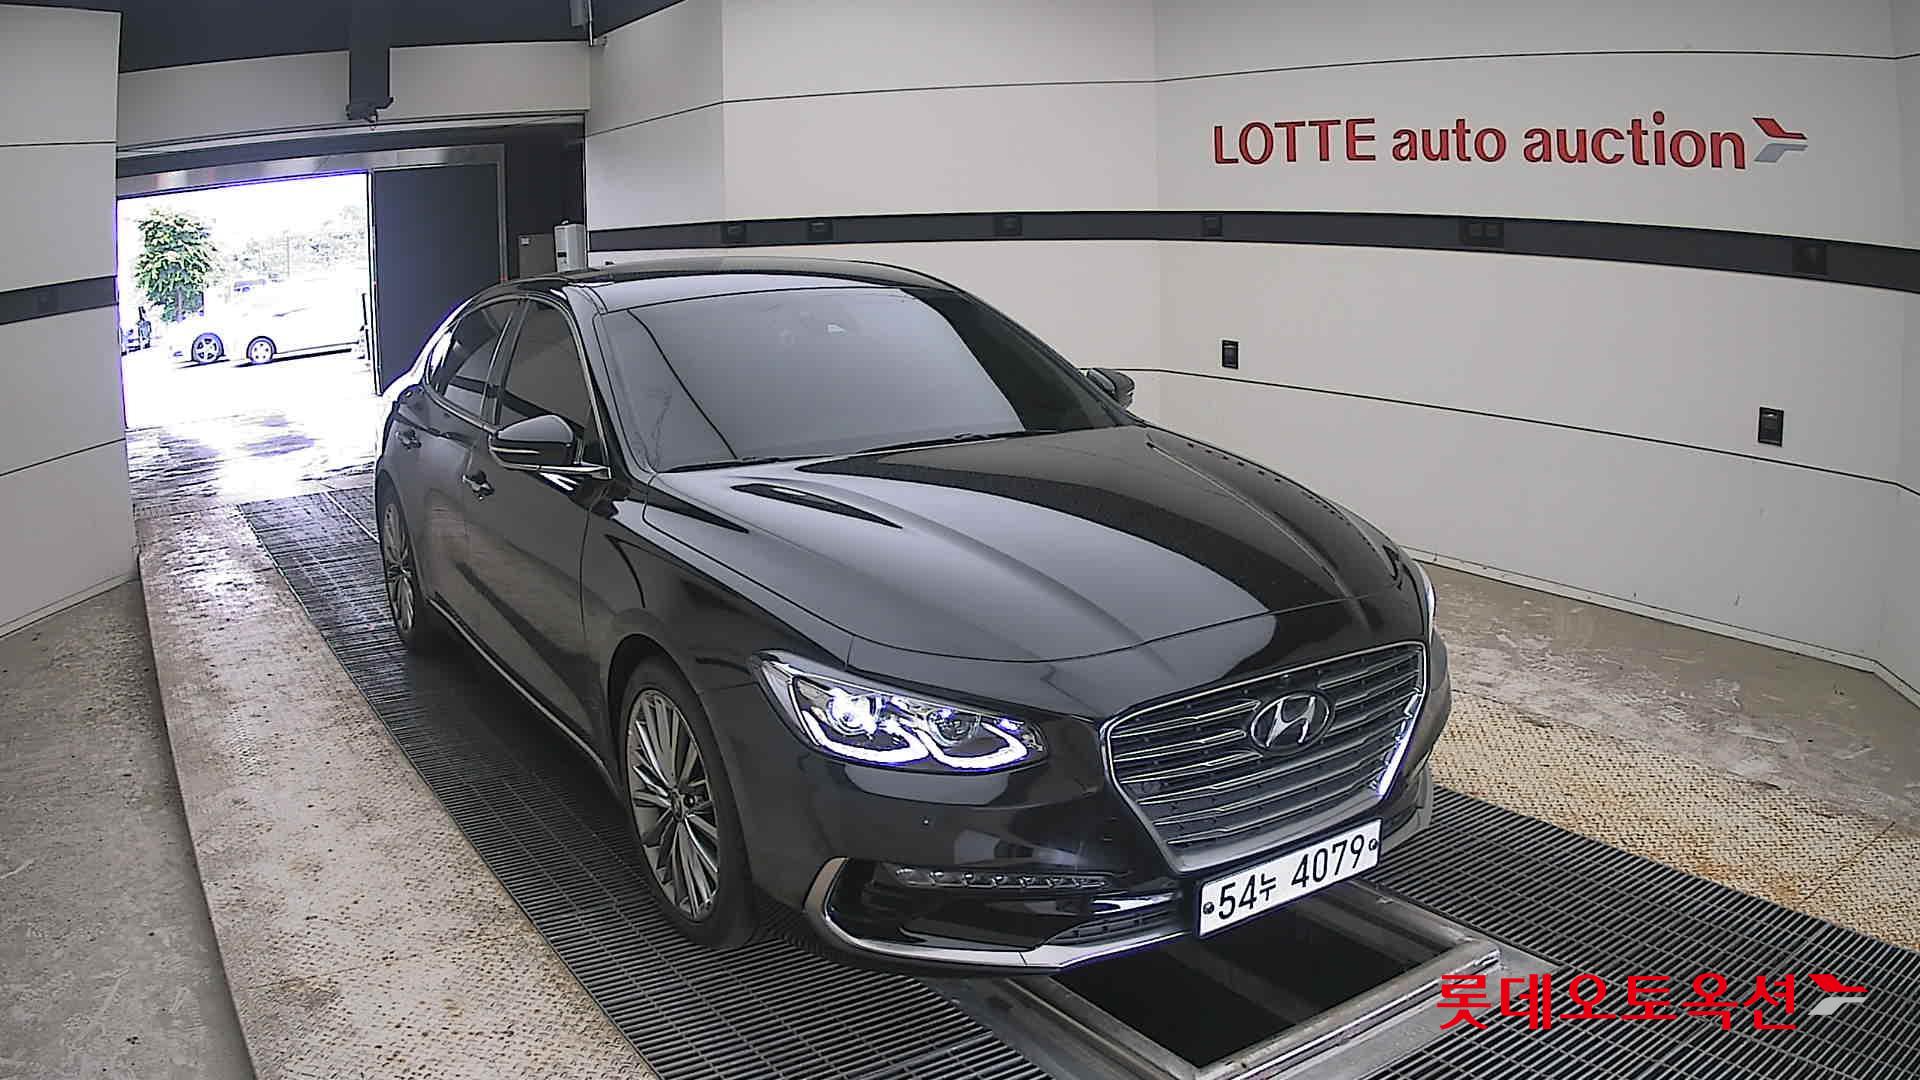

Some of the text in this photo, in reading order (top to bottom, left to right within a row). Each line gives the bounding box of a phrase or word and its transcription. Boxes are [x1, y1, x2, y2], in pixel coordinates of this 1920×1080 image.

[1213, 111, 1747, 170] LOTTE auto auction
[1218, 834, 1365, 920] 54누 4079
